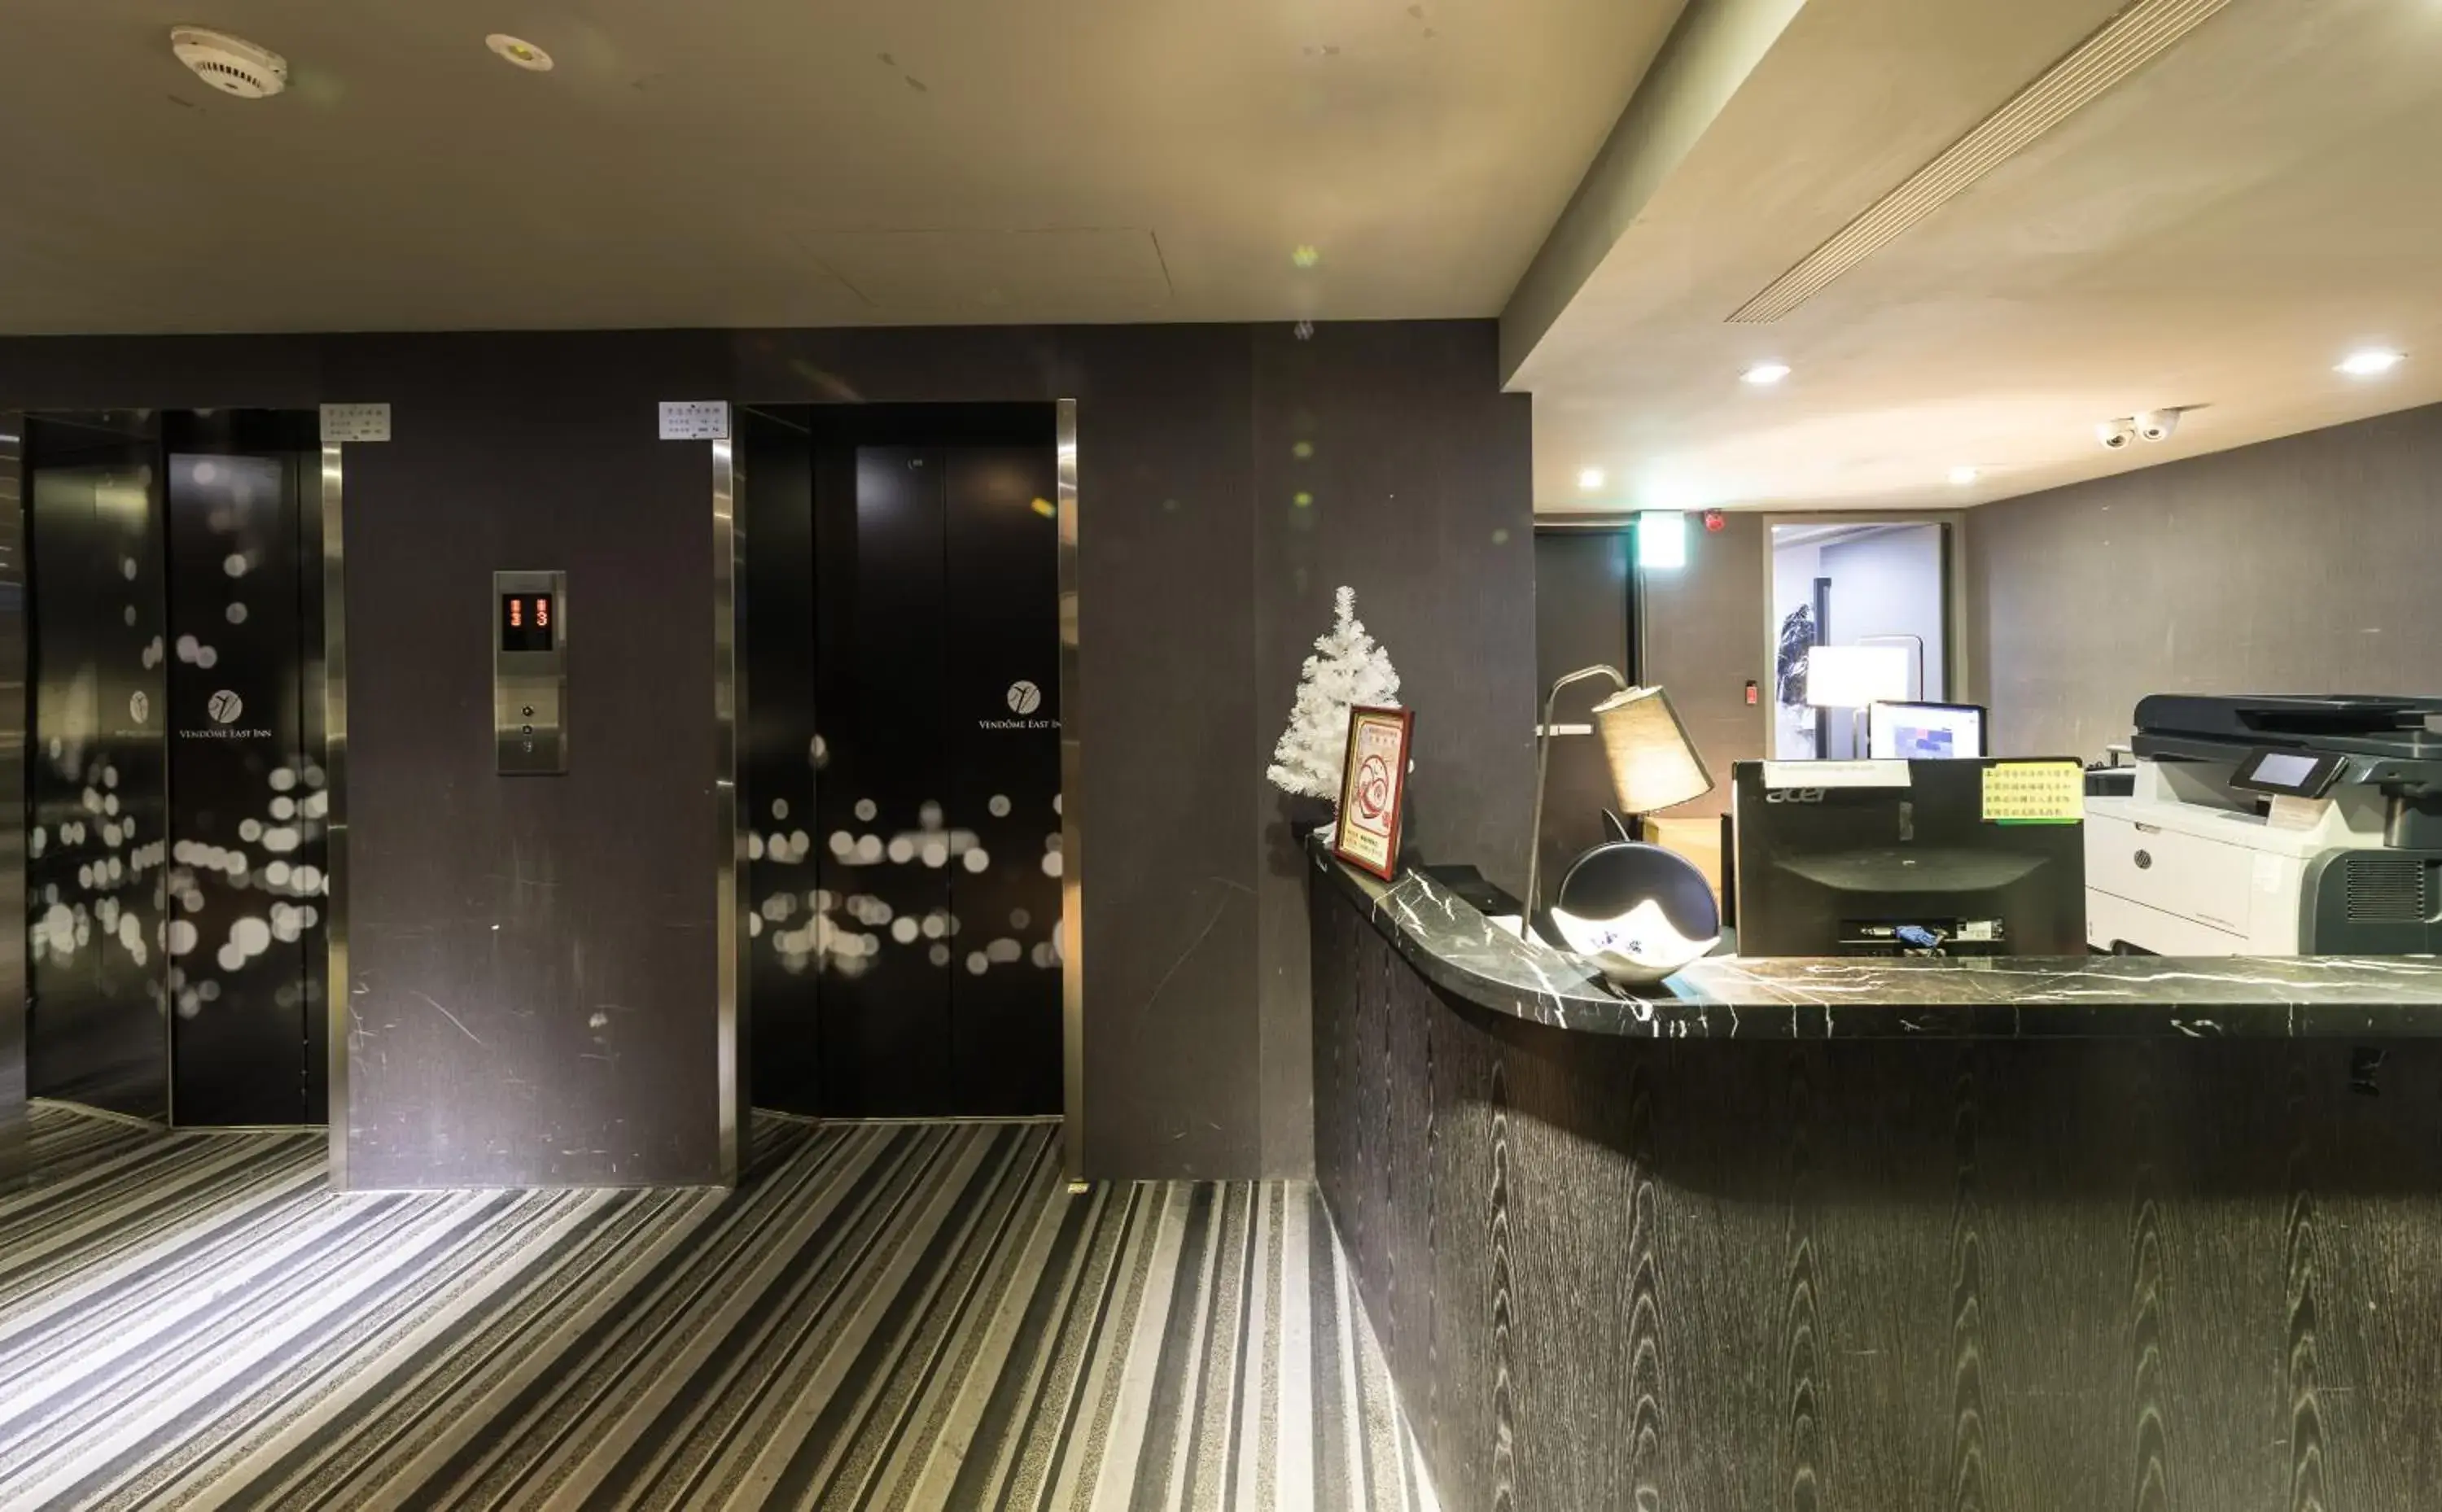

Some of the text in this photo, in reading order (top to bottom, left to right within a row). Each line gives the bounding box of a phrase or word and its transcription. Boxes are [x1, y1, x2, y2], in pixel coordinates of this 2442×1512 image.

[1028, 720, 1048, 729] EAST
[230, 729, 251, 738] EAST
[253, 729, 273, 738] INN
[1766, 786, 1827, 803] acer
